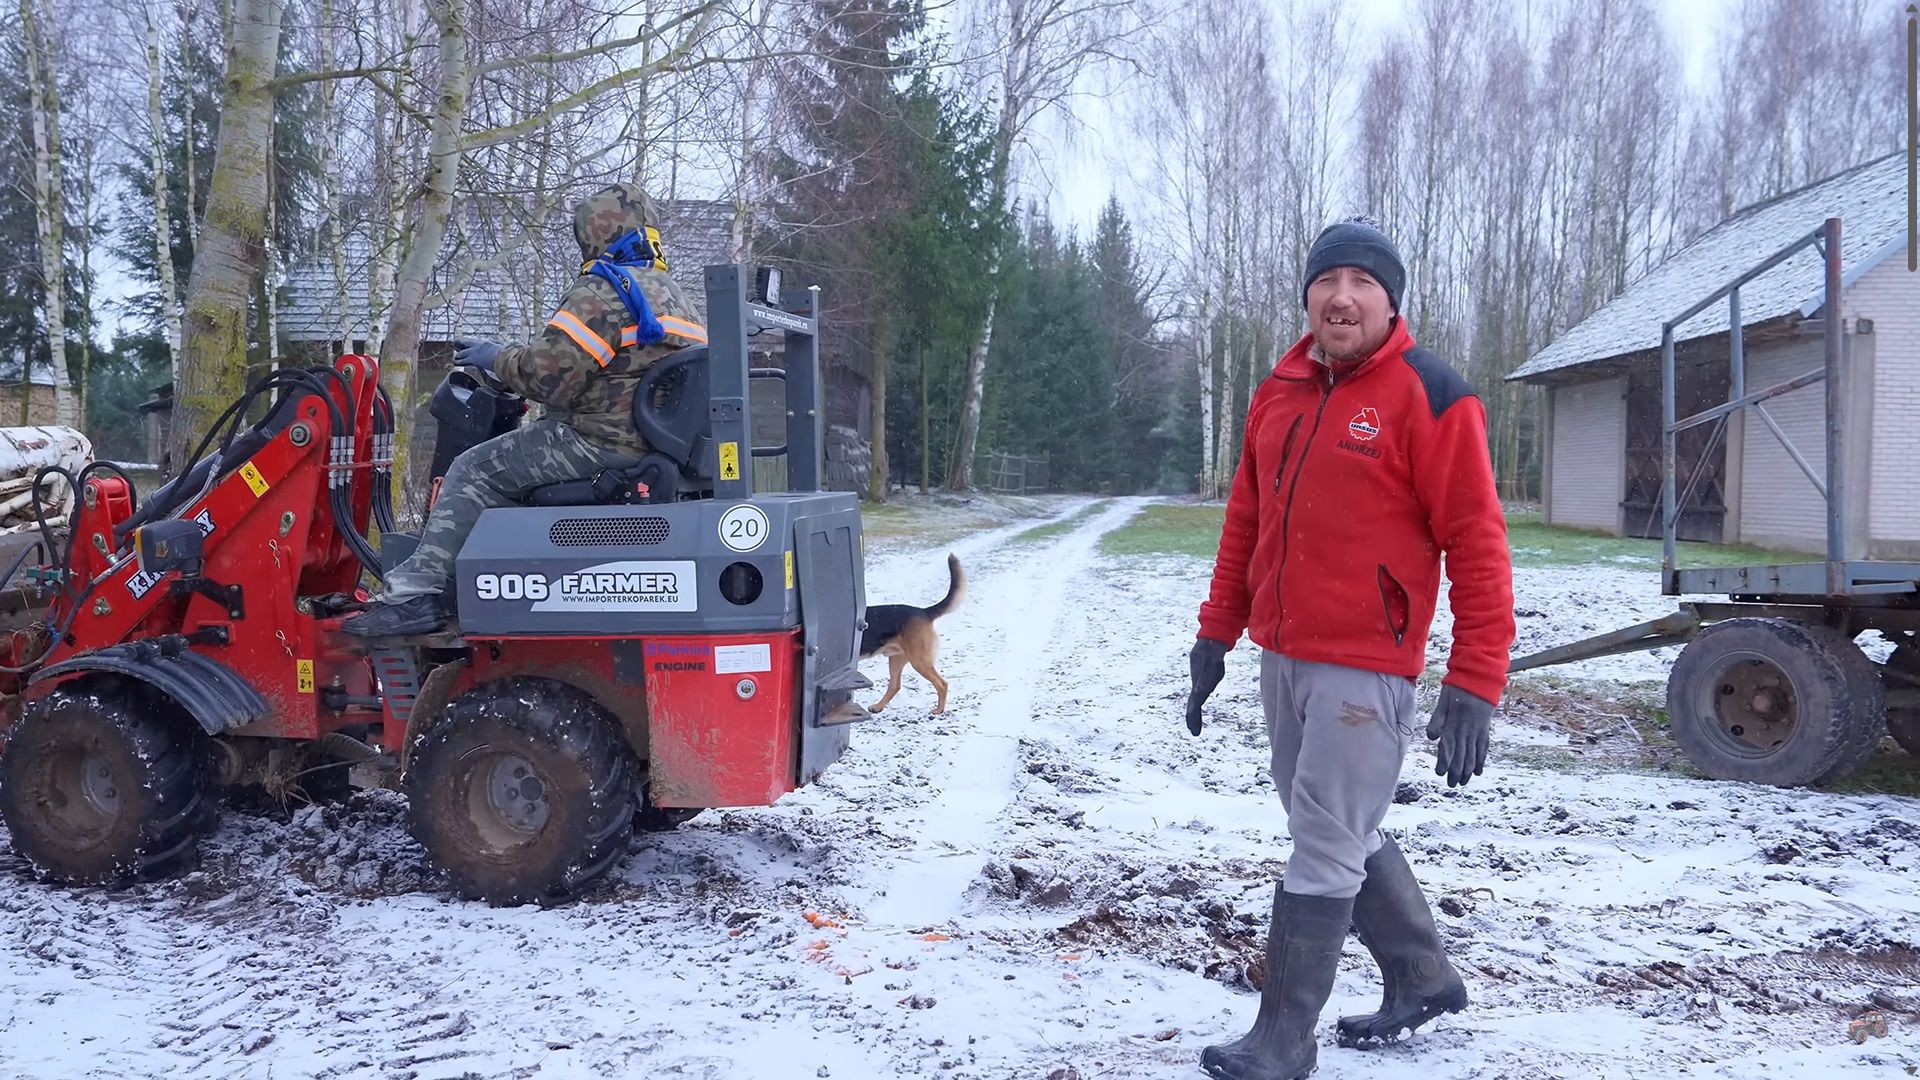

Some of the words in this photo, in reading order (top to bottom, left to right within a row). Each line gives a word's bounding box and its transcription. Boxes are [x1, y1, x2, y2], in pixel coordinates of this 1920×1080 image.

[1336, 440, 1382, 459] ANDRZEJ
[730, 518, 758, 537] 20
[475, 573, 549, 601] 906
[561, 573, 678, 594] FARMER
[561, 595, 679, 604] WWW.IMPORTERKOPAREK.EU
[654, 662, 706, 671] ENGINE
